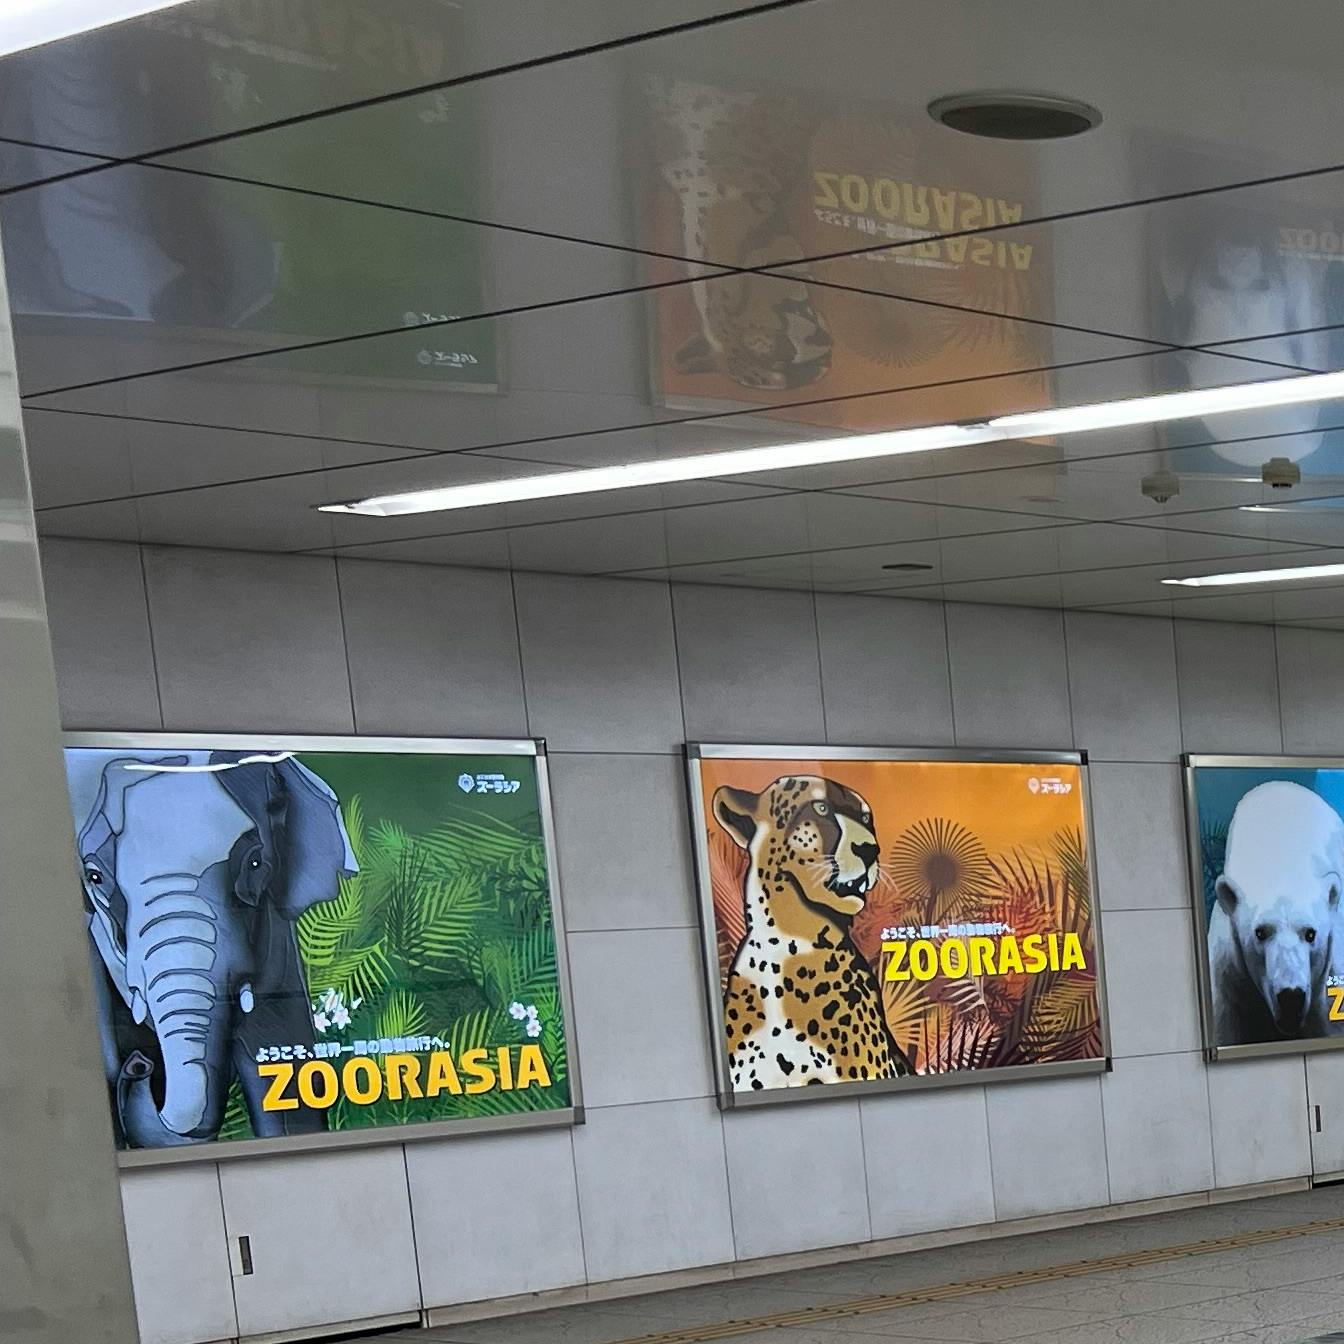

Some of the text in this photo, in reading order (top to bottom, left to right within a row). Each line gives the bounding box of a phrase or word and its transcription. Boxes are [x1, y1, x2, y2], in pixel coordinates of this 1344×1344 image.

[476, 780, 520, 793] ズーラシア
[881, 932, 1087, 982] ZOORASIA
[257, 1044, 552, 1112] ZOORASIA
